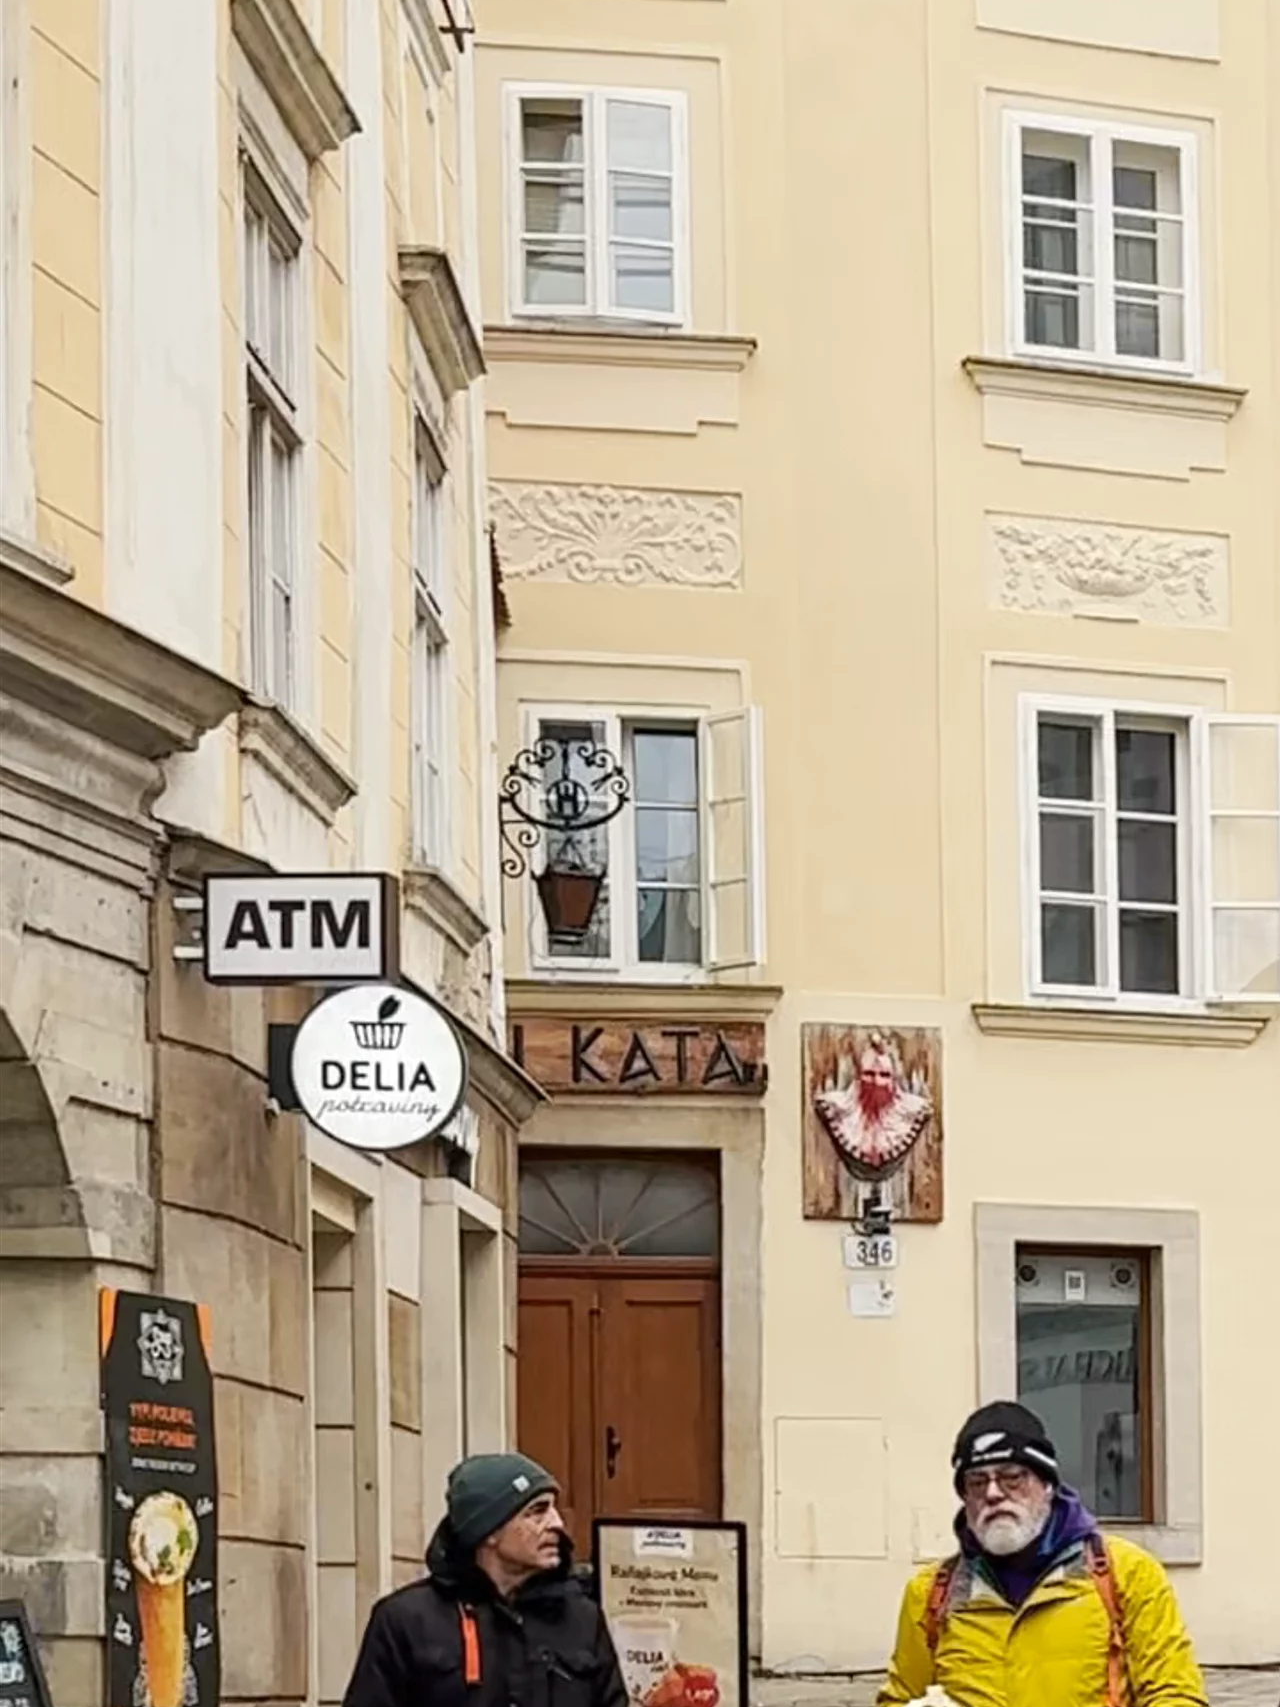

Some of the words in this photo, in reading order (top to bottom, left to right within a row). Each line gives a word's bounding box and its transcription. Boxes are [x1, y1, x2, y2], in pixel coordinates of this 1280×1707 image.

[224, 899, 370, 949] ATM
[320, 1060, 436, 1092] DELIA
[317, 1095, 441, 1122] potraviny
